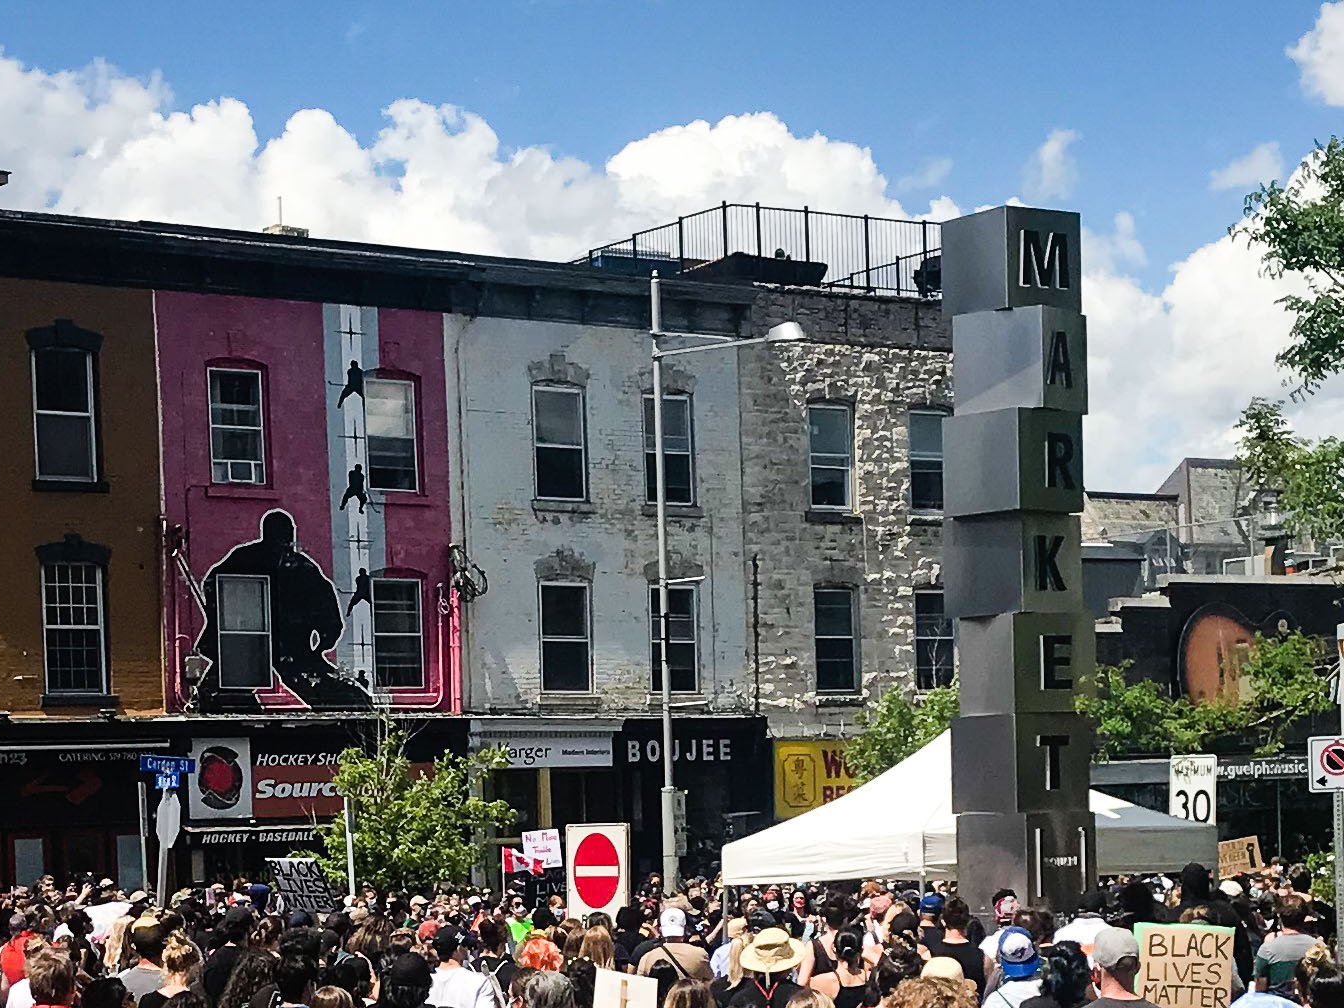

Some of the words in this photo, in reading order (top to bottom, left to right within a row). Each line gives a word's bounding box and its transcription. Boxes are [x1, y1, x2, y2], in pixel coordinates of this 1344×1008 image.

[1019, 229, 1077, 791] MARKET
[58, 752, 106, 762] CATERING
[147, 757, 176, 771] Carden
[256, 753, 316, 767] HOCKEY
[1175, 789, 1212, 823] 30
[201, 833, 250, 844] HOCKEY
[258, 830, 315, 842] BASEBALL
[1148, 933, 1231, 961] BLACK
[1146, 961, 1222, 985] LIVES
